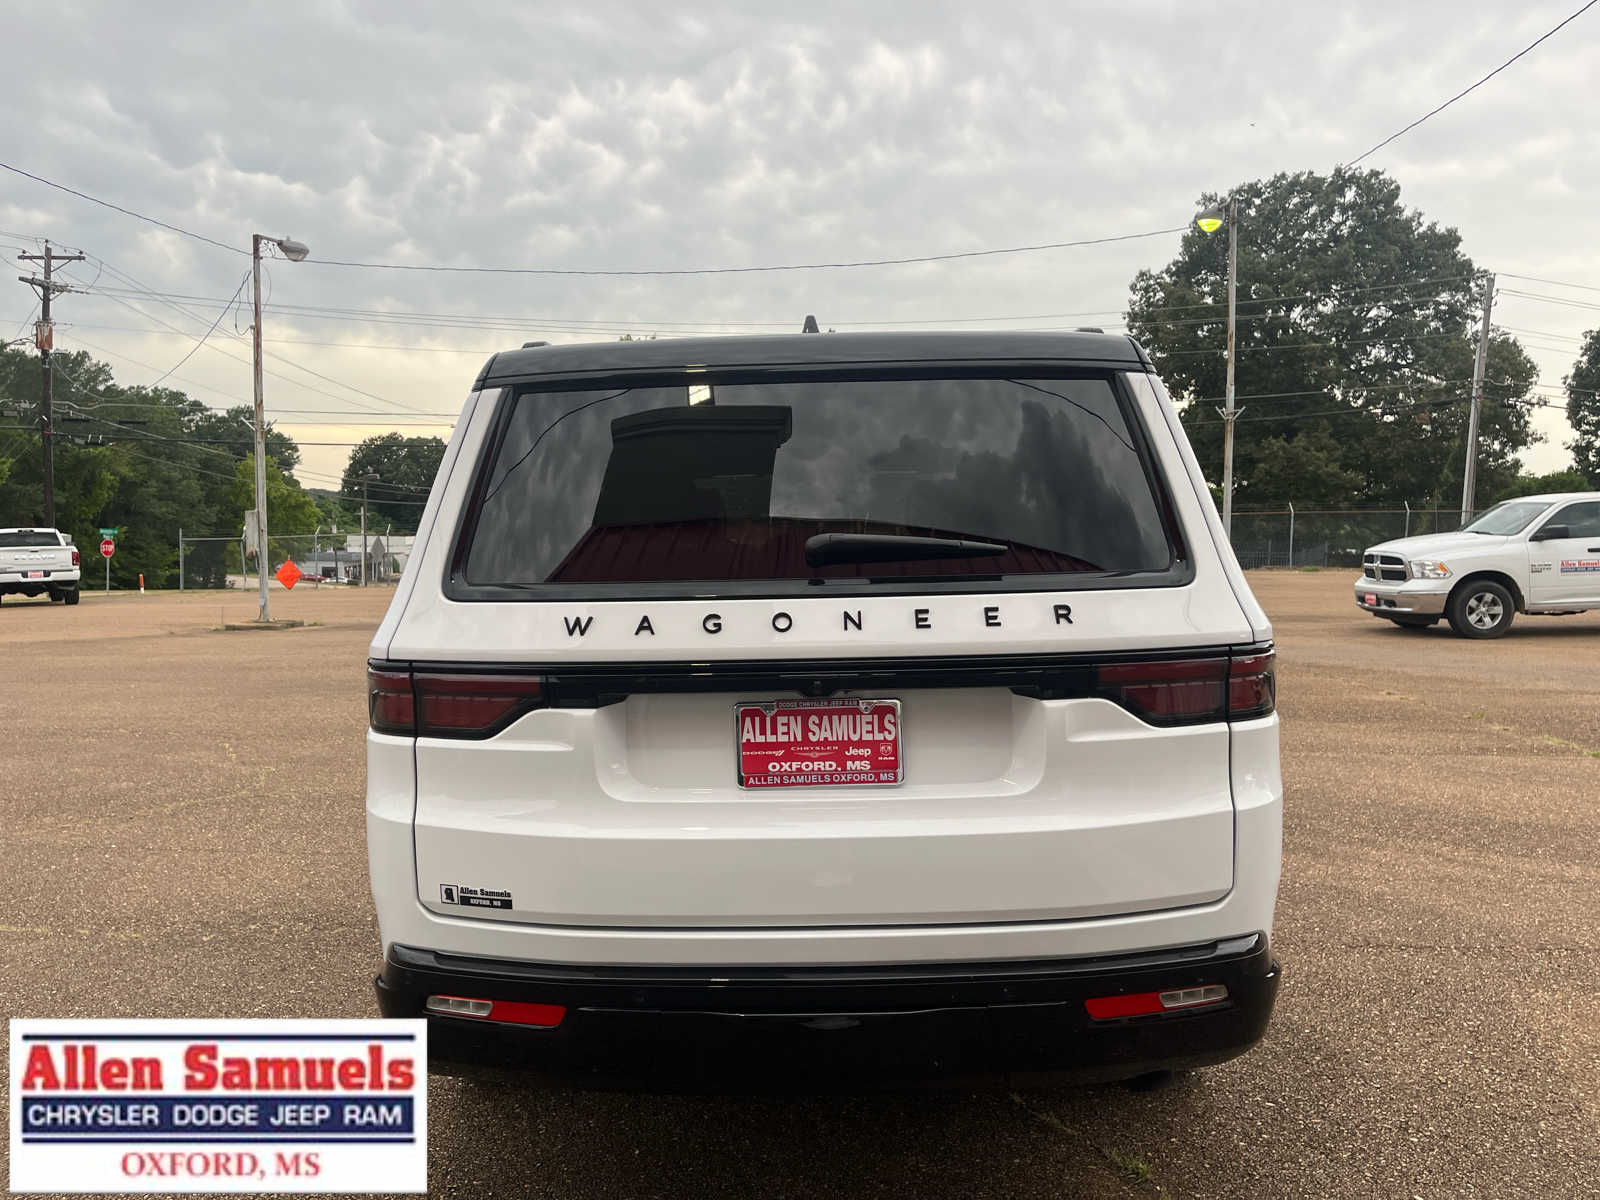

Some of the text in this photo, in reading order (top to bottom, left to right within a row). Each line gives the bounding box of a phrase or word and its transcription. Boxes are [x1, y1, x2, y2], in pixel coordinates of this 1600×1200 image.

[102, 544, 114, 552] STOP
[564, 604, 1074, 637] WAGONEER
[742, 714, 896, 743] ALLEN SAMUELS
[845, 746, 871, 757] Jeep
[847, 760, 871, 771] MS
[748, 773, 895, 785] ALLEN SAMUELS OXFORD, MS
[460, 887, 511, 898] Allen Samuels
